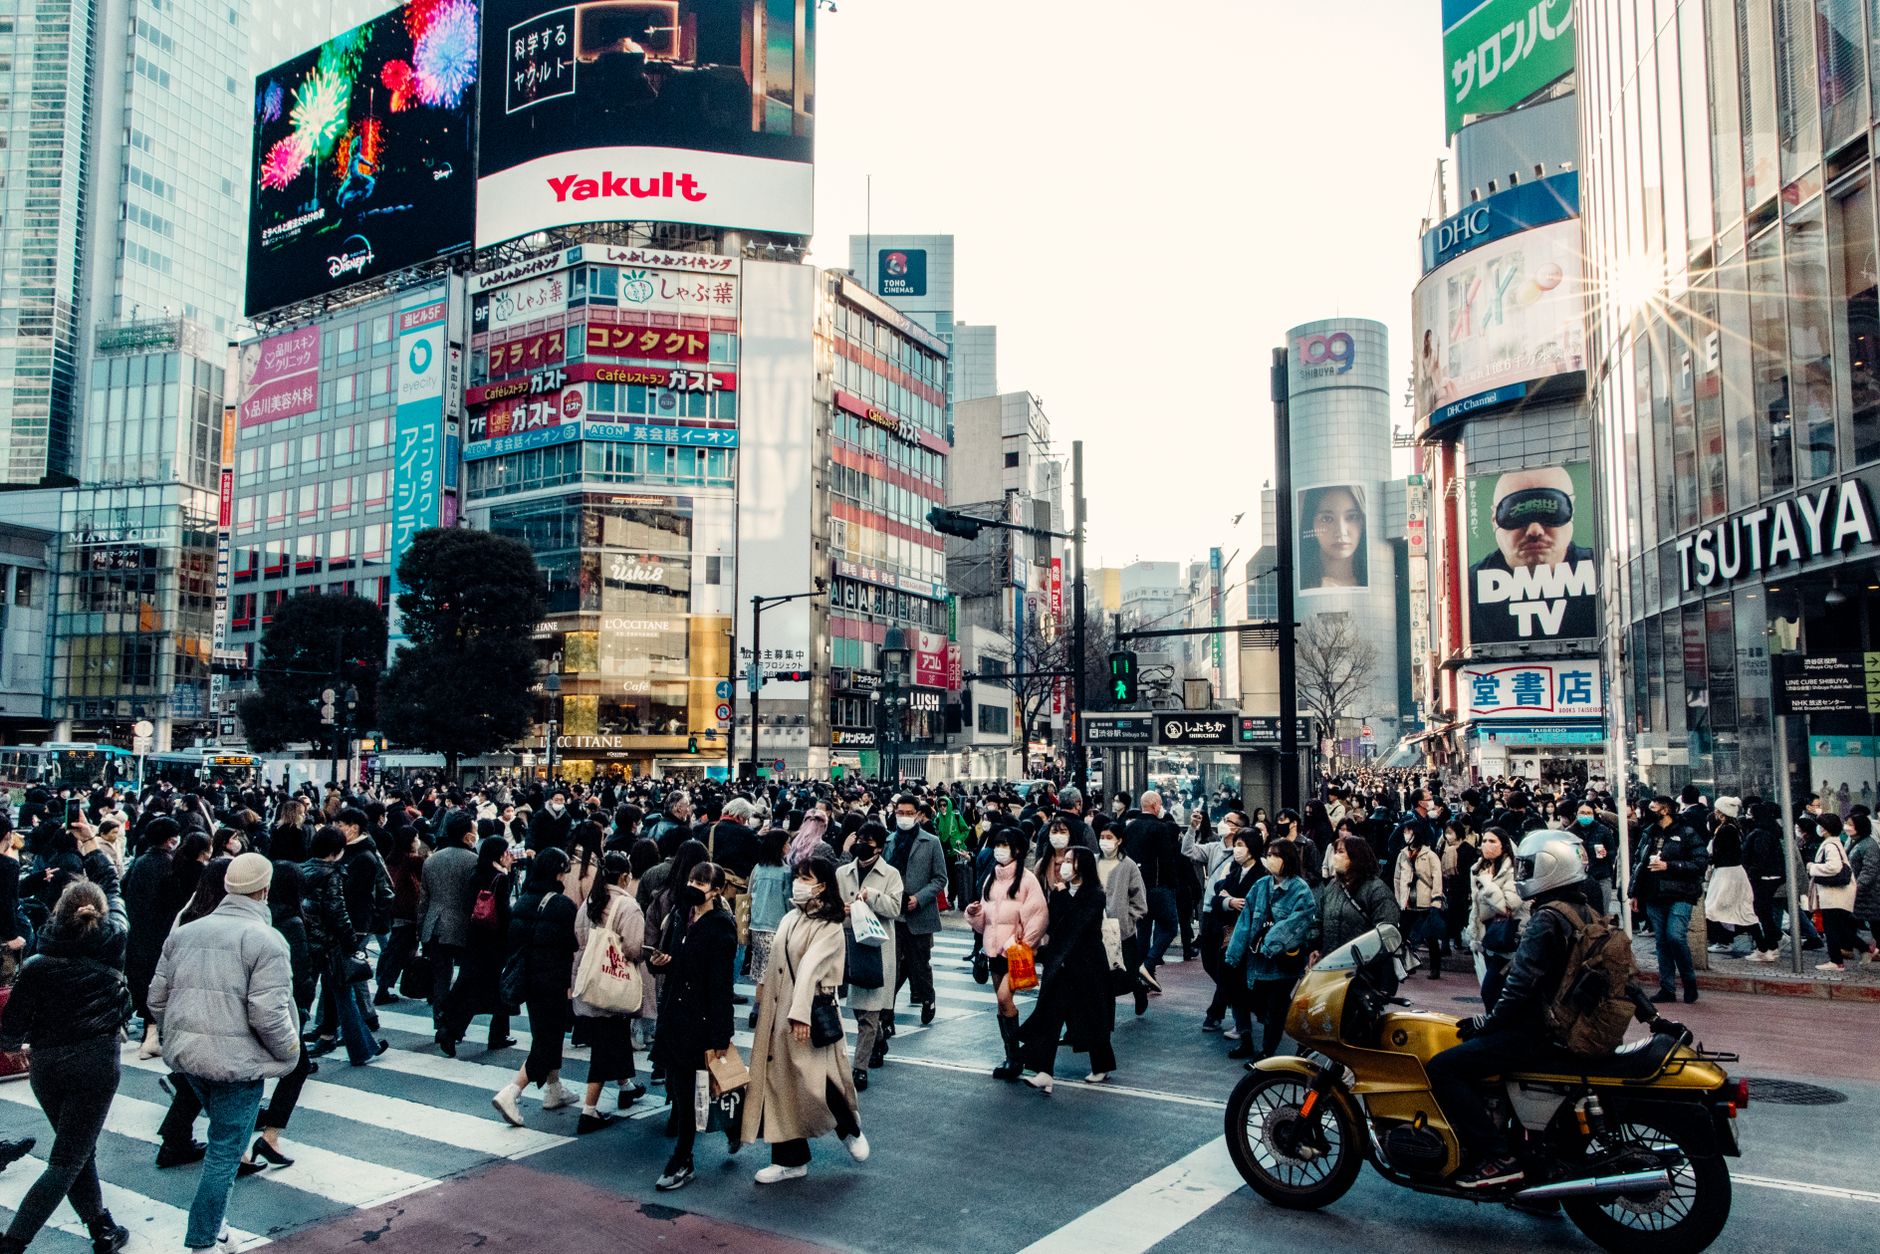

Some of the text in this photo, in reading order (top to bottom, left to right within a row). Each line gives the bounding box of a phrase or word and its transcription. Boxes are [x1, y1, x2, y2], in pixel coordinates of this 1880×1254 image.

[514, 24, 567, 61] 科学する
[1452, 0, 1574, 104] サロンパ
[514, 57, 566, 92] ヤクルト
[546, 171, 708, 203] Yakult
[1438, 206, 1490, 252] DHC
[327, 250, 375, 278] Disney+
[479, 253, 560, 288] しゃぶしゃぶバイキング
[606, 248, 733, 271] しゃぶしゃぶバイキング
[660, 278, 734, 305] しゃぶ葉
[884, 279, 906, 287] TOHO
[884, 286, 914, 294] CINEMAS
[516, 280, 563, 311] しゃぶ葉
[404, 305, 441, 327] 当ビル5F
[475, 305, 489, 322] 9F
[275, 335, 316, 357] 品川スキン
[490, 333, 563, 370] プライス
[588, 327, 705, 355] コンタクト
[275, 352, 311, 373] クリニック
[1294, 332, 1355, 376] 109
[530, 369, 567, 394] ガスト
[668, 370, 722, 392] ガスト
[1299, 366, 1335, 380] SHIBUYA
[402, 376, 438, 394] eyecity
[250, 386, 314, 418] 品川美容外科
[1447, 393, 1498, 417] DHC Channel
[470, 416, 487, 434] 7F
[511, 401, 557, 433] ガスト
[494, 430, 560, 453] 英会話イーオン
[589, 425, 736, 445] AEON 英会話イーオン
[419, 423, 435, 528] コンタクト
[68, 528, 169, 544] MARK CITY
[1675, 479, 1872, 592] TSUTAYA
[936, 584, 948, 600] 4F
[1476, 559, 1596, 604] DMM
[830, 580, 869, 609] AGA
[604, 618, 670, 631] L'OCCITANE
[1508, 599, 1568, 638] TV
[742, 649, 804, 660] 広主募集中
[922, 654, 942, 670] アコム
[623, 680, 649, 692] Café
[1472, 670, 1593, 707] 堂書店
[910, 691, 940, 712] LUSH
[540, 736, 623, 748] L'CCITANE
[1099, 730, 1121, 738] 渋谷駅
[1121, 731, 1140, 739] Shibuya
